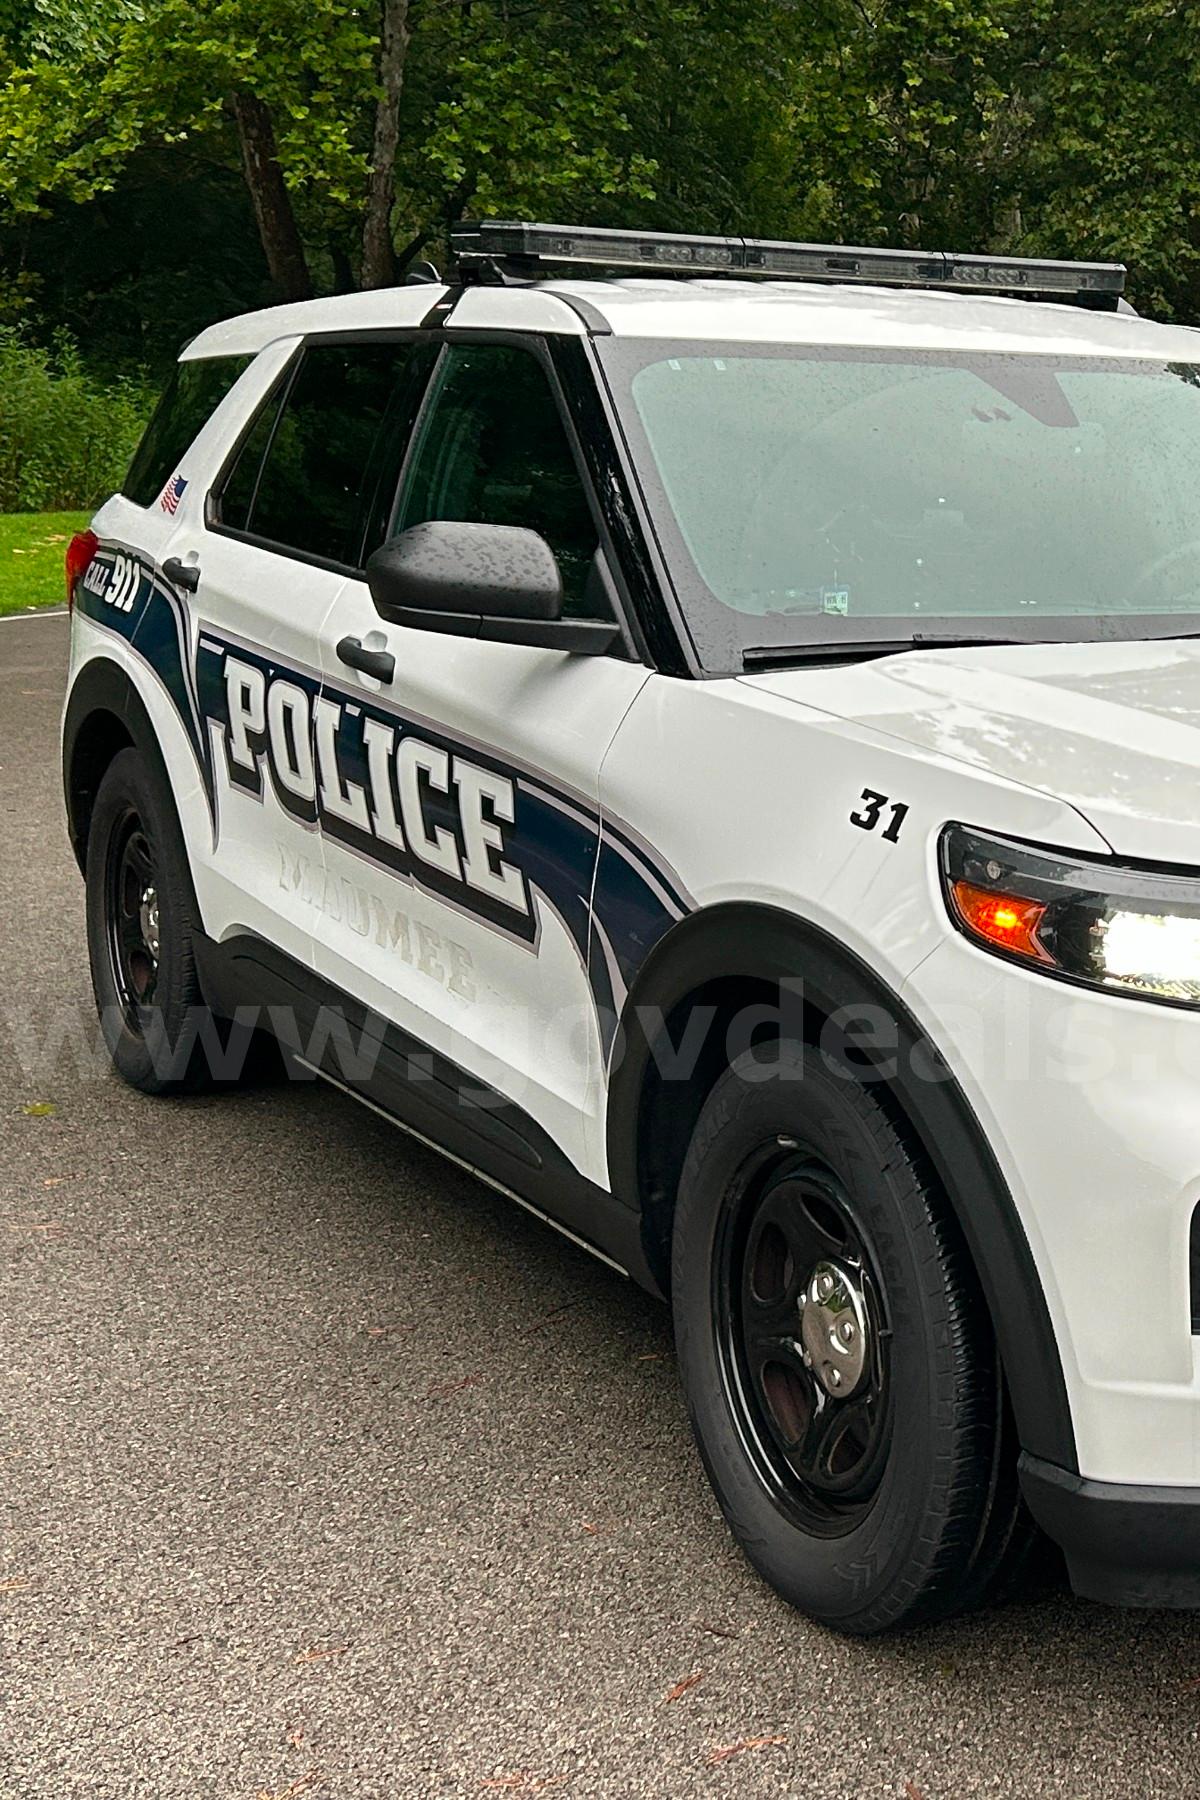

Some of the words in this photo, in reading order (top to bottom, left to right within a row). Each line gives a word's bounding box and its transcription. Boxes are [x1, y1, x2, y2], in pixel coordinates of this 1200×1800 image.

[83, 560, 110, 597] CALL
[104, 554, 140, 613] 911
[223, 655, 530, 917] POLICE
[849, 787, 910, 844] 31
